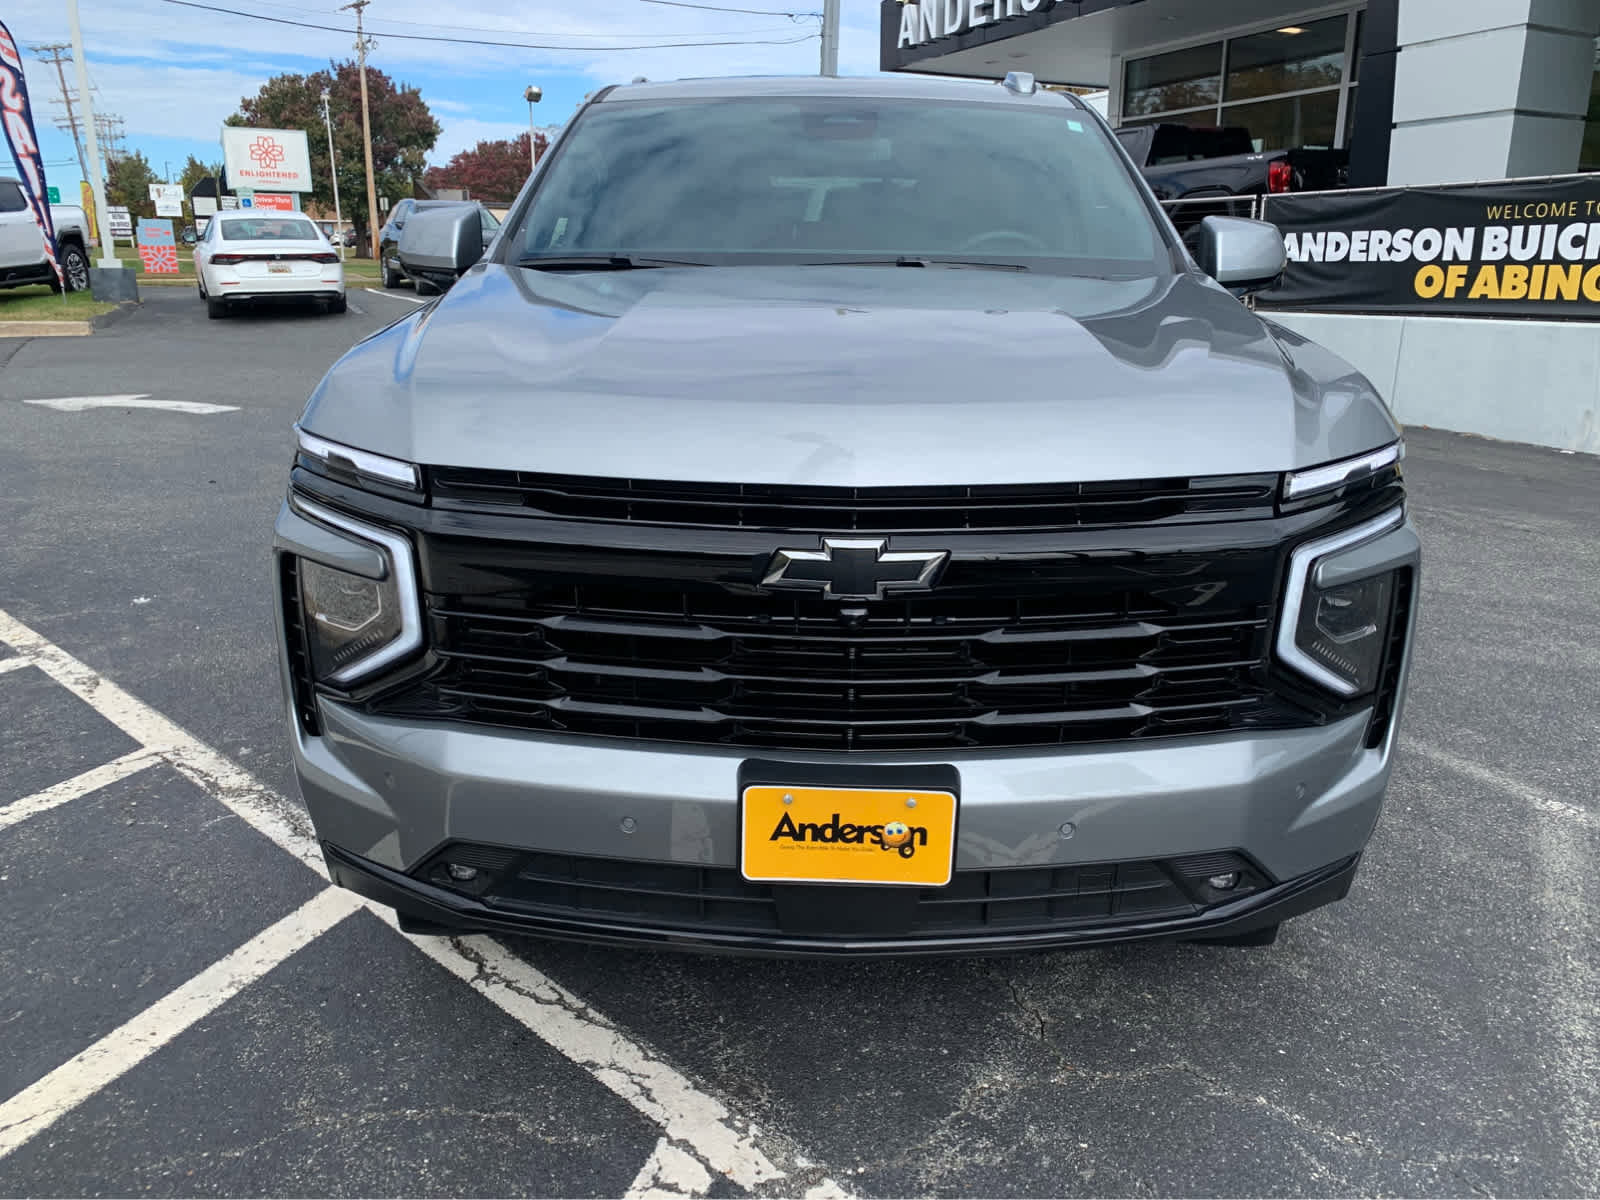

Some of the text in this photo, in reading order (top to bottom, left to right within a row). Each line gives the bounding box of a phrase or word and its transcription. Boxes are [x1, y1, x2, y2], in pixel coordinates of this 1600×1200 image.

[897, 0, 1064, 48] ANDE
[239, 169, 298, 179] ENLIGHTENED
[1487, 201, 1577, 219] WELCOME
[1284, 226, 1475, 263] ANDERSON
[1414, 264, 1468, 299] OF
